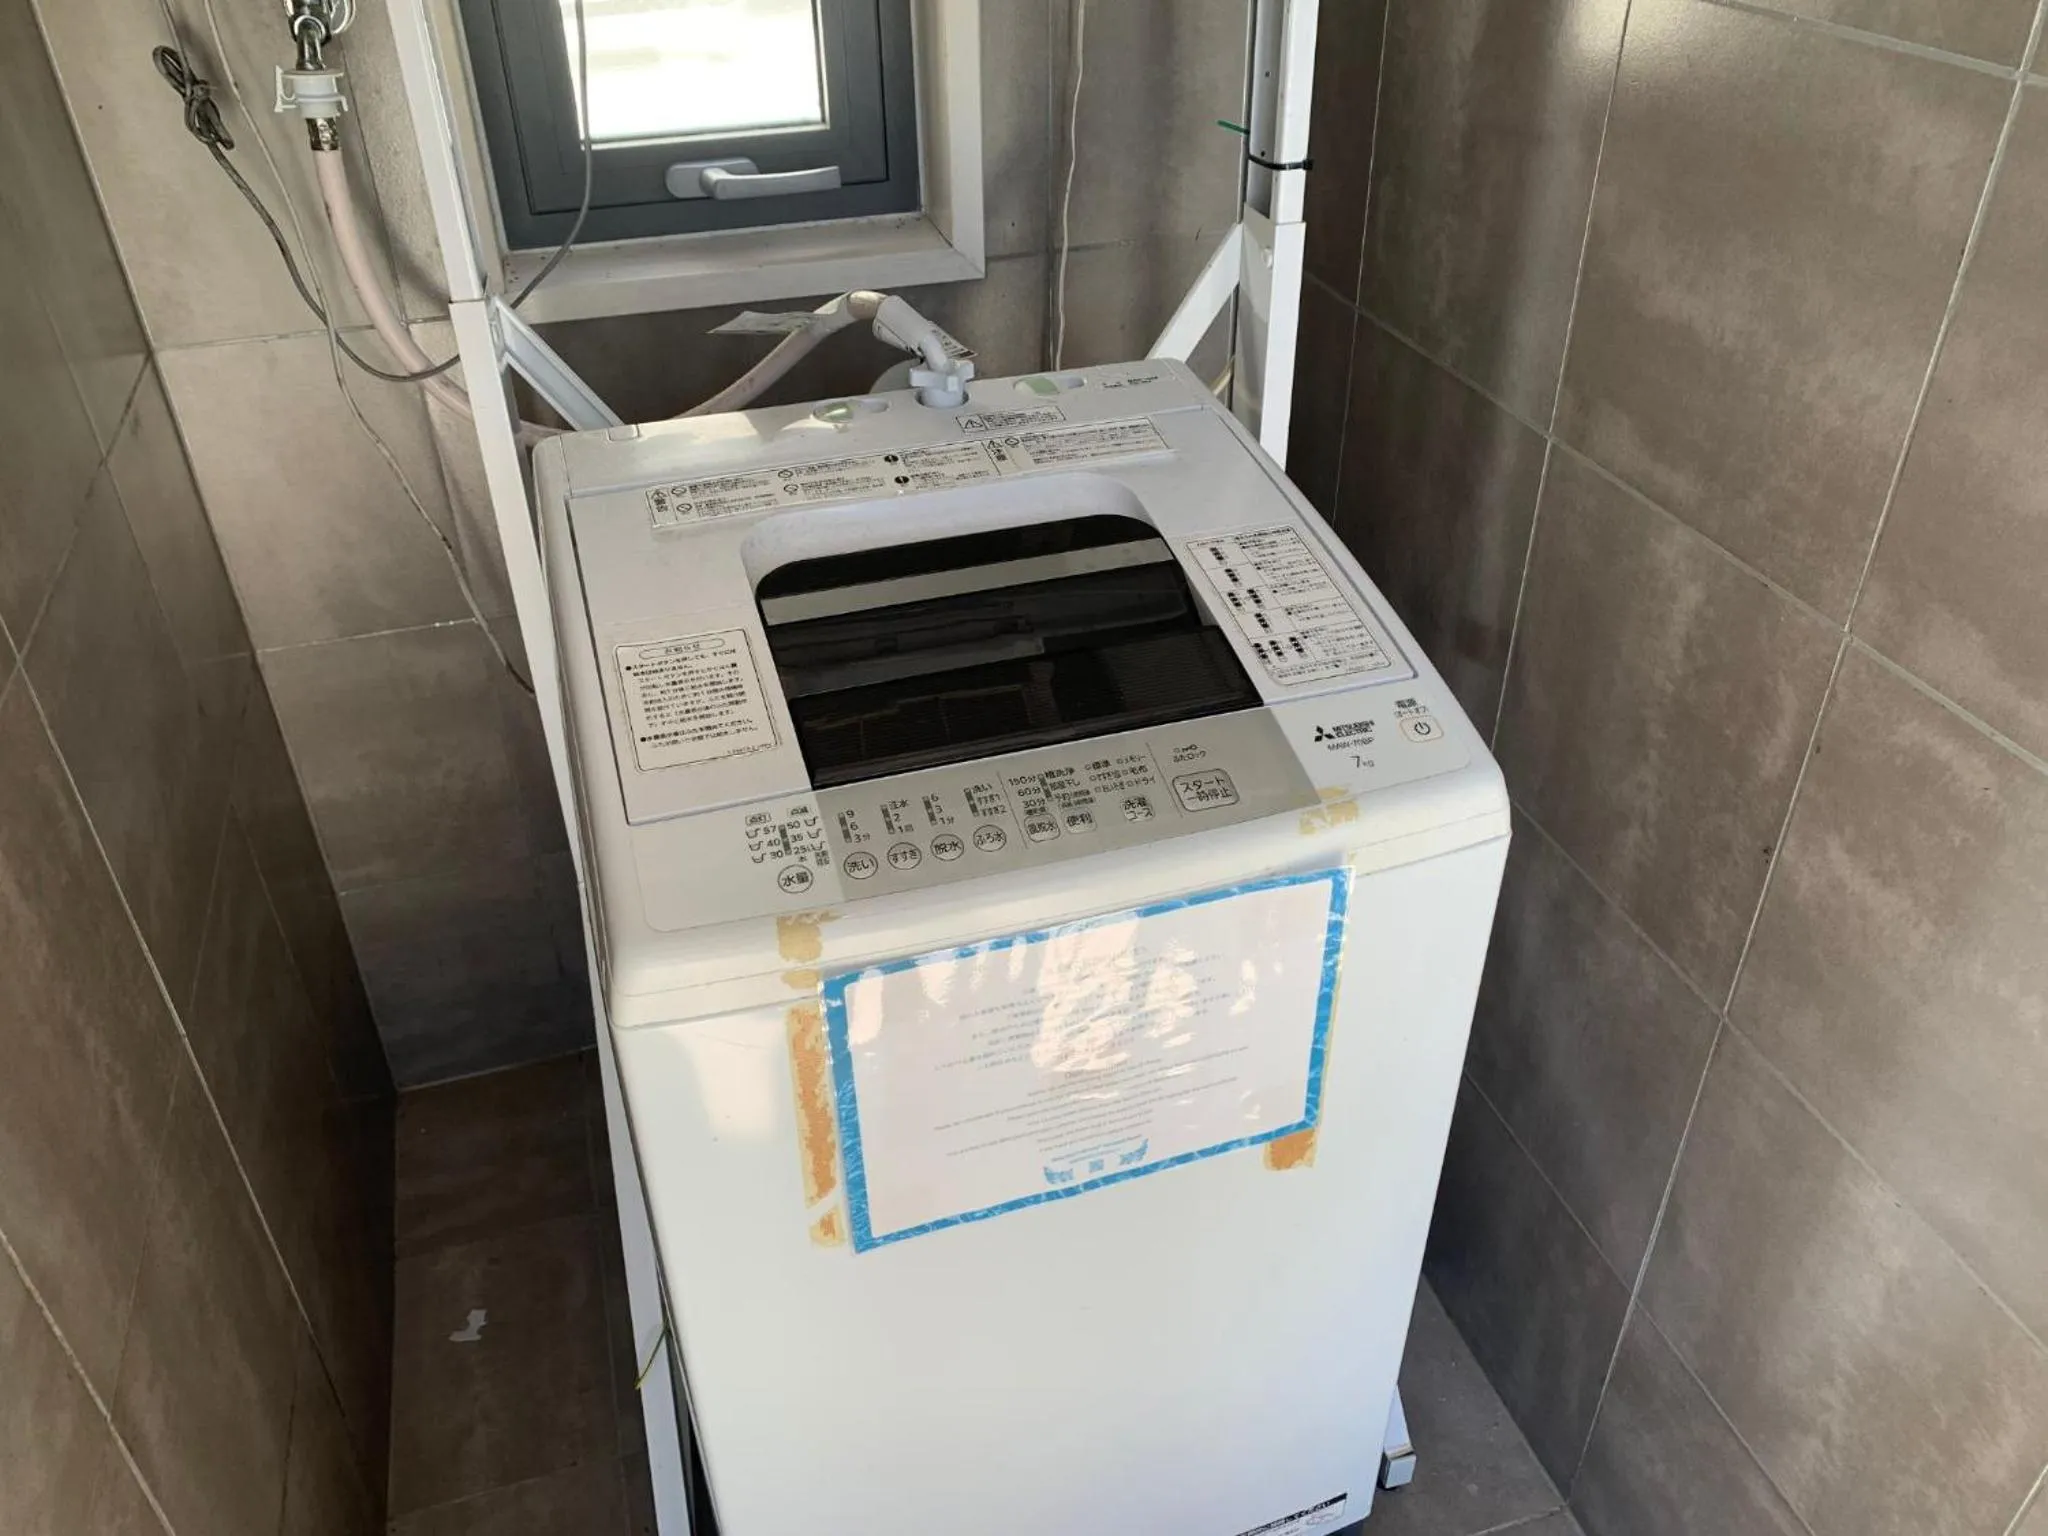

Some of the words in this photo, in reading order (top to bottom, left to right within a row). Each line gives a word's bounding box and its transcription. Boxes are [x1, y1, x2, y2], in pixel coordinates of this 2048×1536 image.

[1332, 720, 1375, 732] MITSUBISHI
[1176, 775, 1225, 794] スタート
[1186, 786, 1233, 802] 一時停止
[1067, 812, 1093, 827] 便利
[1126, 807, 1153, 821] コース
[787, 820, 801, 829] 50
[767, 838, 781, 847] 40
[976, 831, 1004, 846] ふろ水
[889, 848, 918, 864] すすぎ
[847, 858, 875, 873] 洗い
[782, 871, 810, 888] 水量
